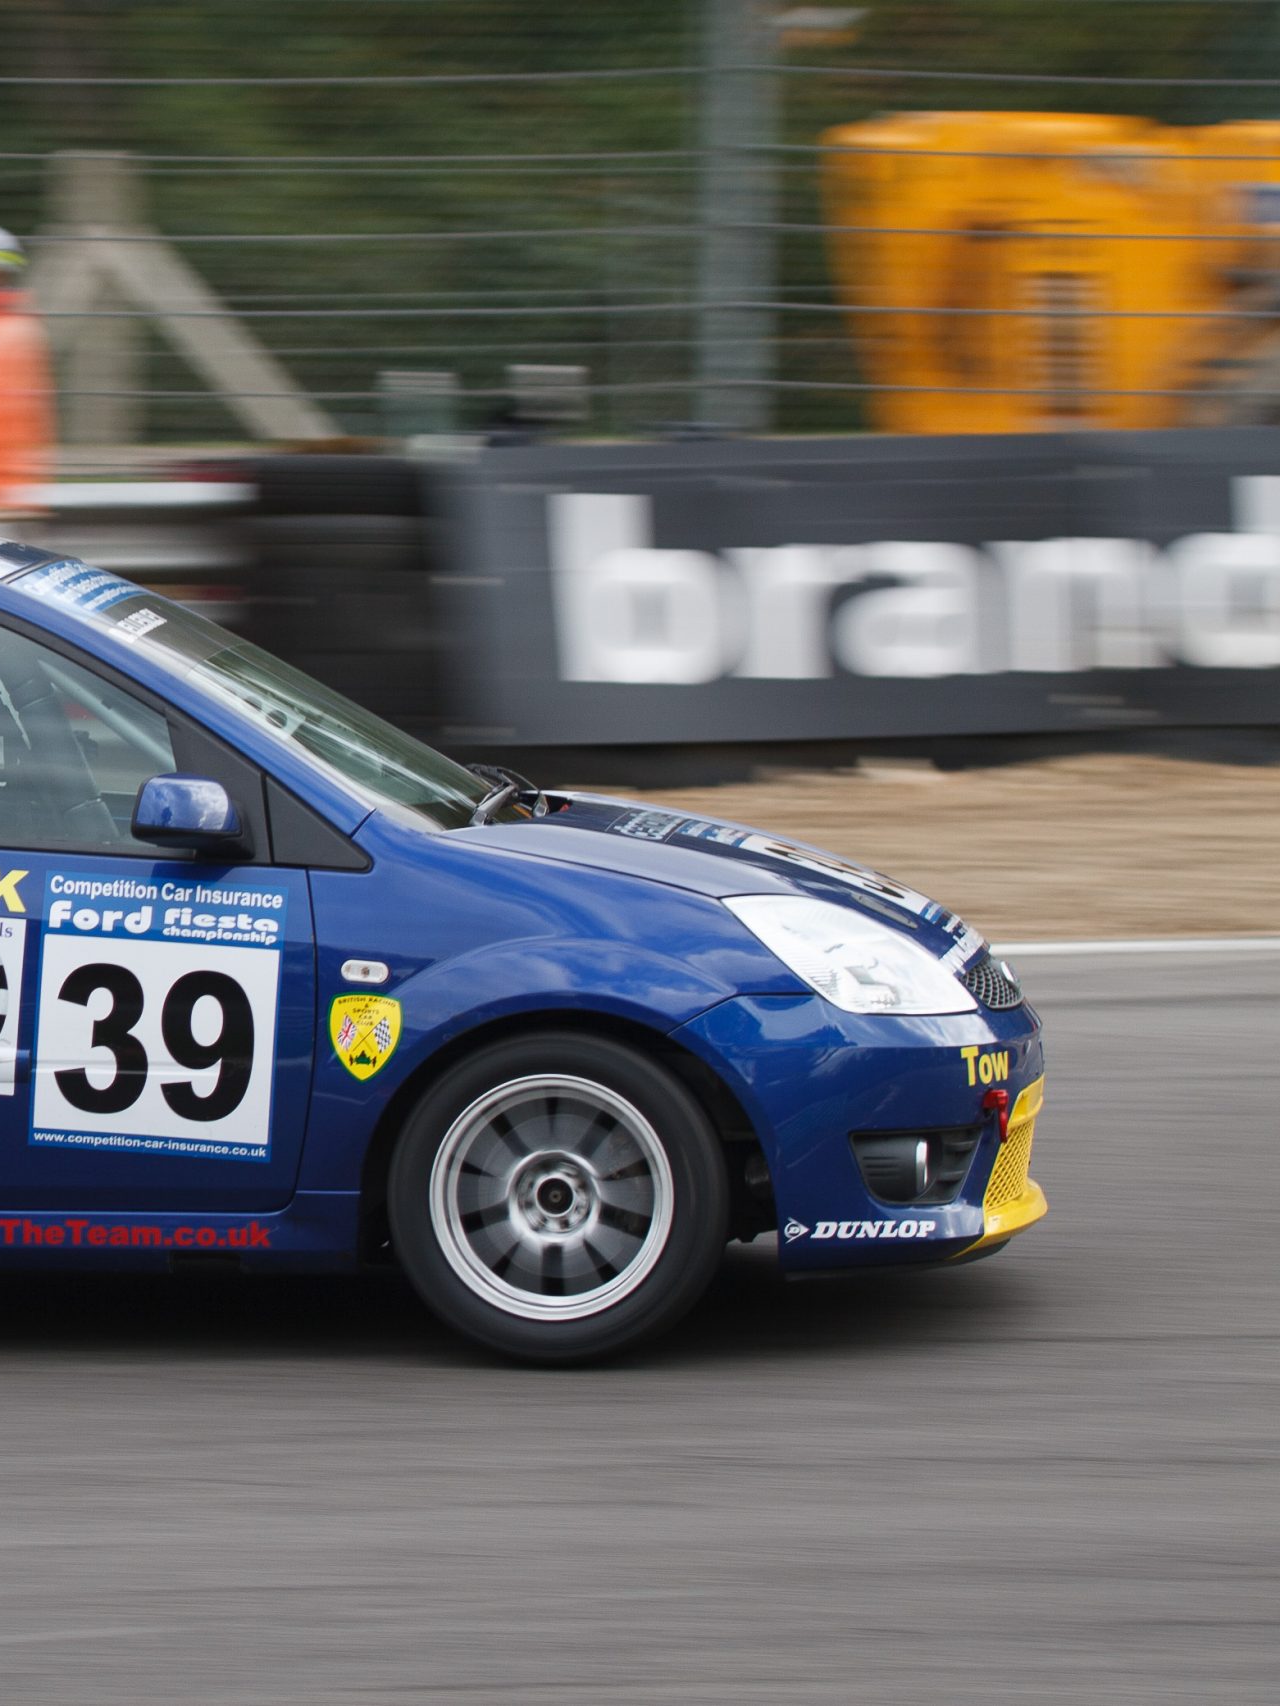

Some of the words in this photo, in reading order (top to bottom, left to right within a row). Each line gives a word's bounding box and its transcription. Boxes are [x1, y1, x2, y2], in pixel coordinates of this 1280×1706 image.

[50, 874, 158, 902] Competition
[161, 882, 193, 903] Car
[195, 884, 283, 910] Insurance
[162, 926, 277, 946] championship
[54, 962, 255, 1123] 39
[960, 1046, 1009, 1087] Tow
[33, 1131, 267, 1158] www.competition-car-insurance.co.uk
[810, 1219, 936, 1239] DUNLOP
